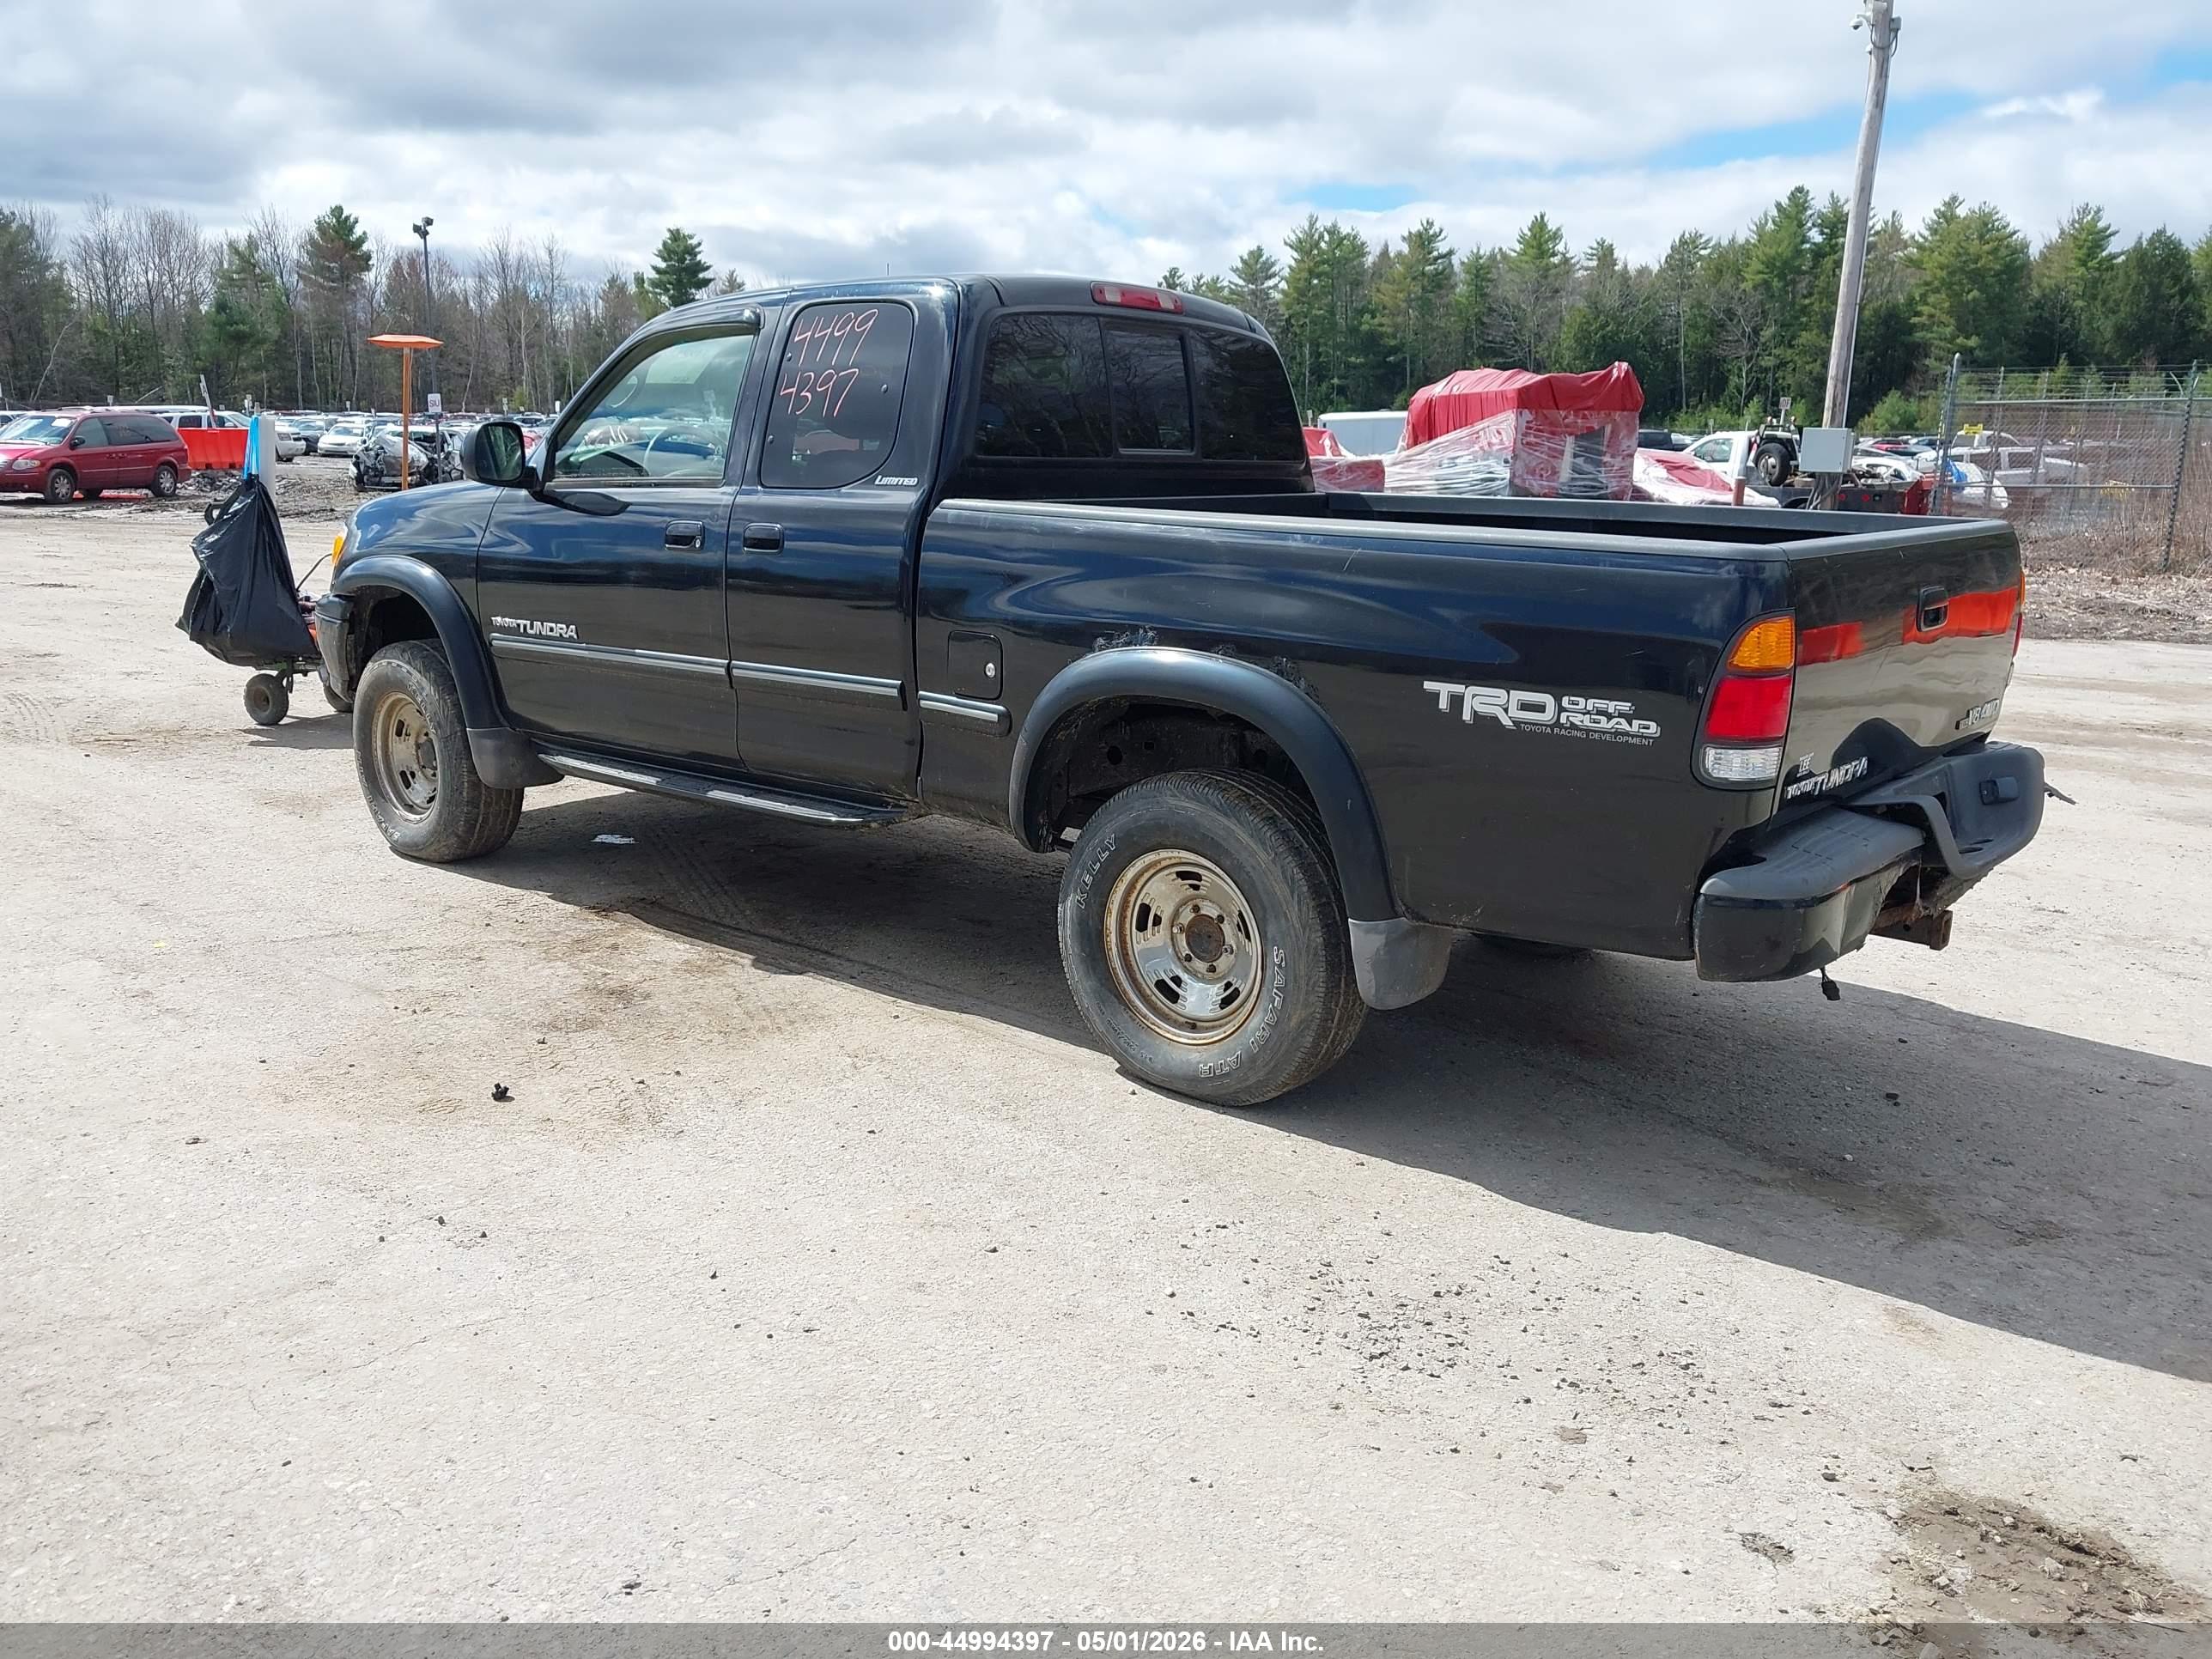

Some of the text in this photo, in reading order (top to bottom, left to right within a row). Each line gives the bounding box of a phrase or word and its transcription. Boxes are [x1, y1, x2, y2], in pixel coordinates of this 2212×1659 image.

[794, 308, 878, 367] 4499
[780, 368, 859, 417] 4397
[490, 616, 578, 639] TOYOTA TUNDRA
[1423, 680, 1558, 729] TRD
[1559, 711, 1661, 738] ROAD
[1561, 695, 1635, 716] OFF
[1520, 723, 1654, 746] TOYOTA RACING DEVELOPMENT
[1075, 833, 1116, 909] KELLY
[1199, 945, 1286, 1078] SAFARI ATR
